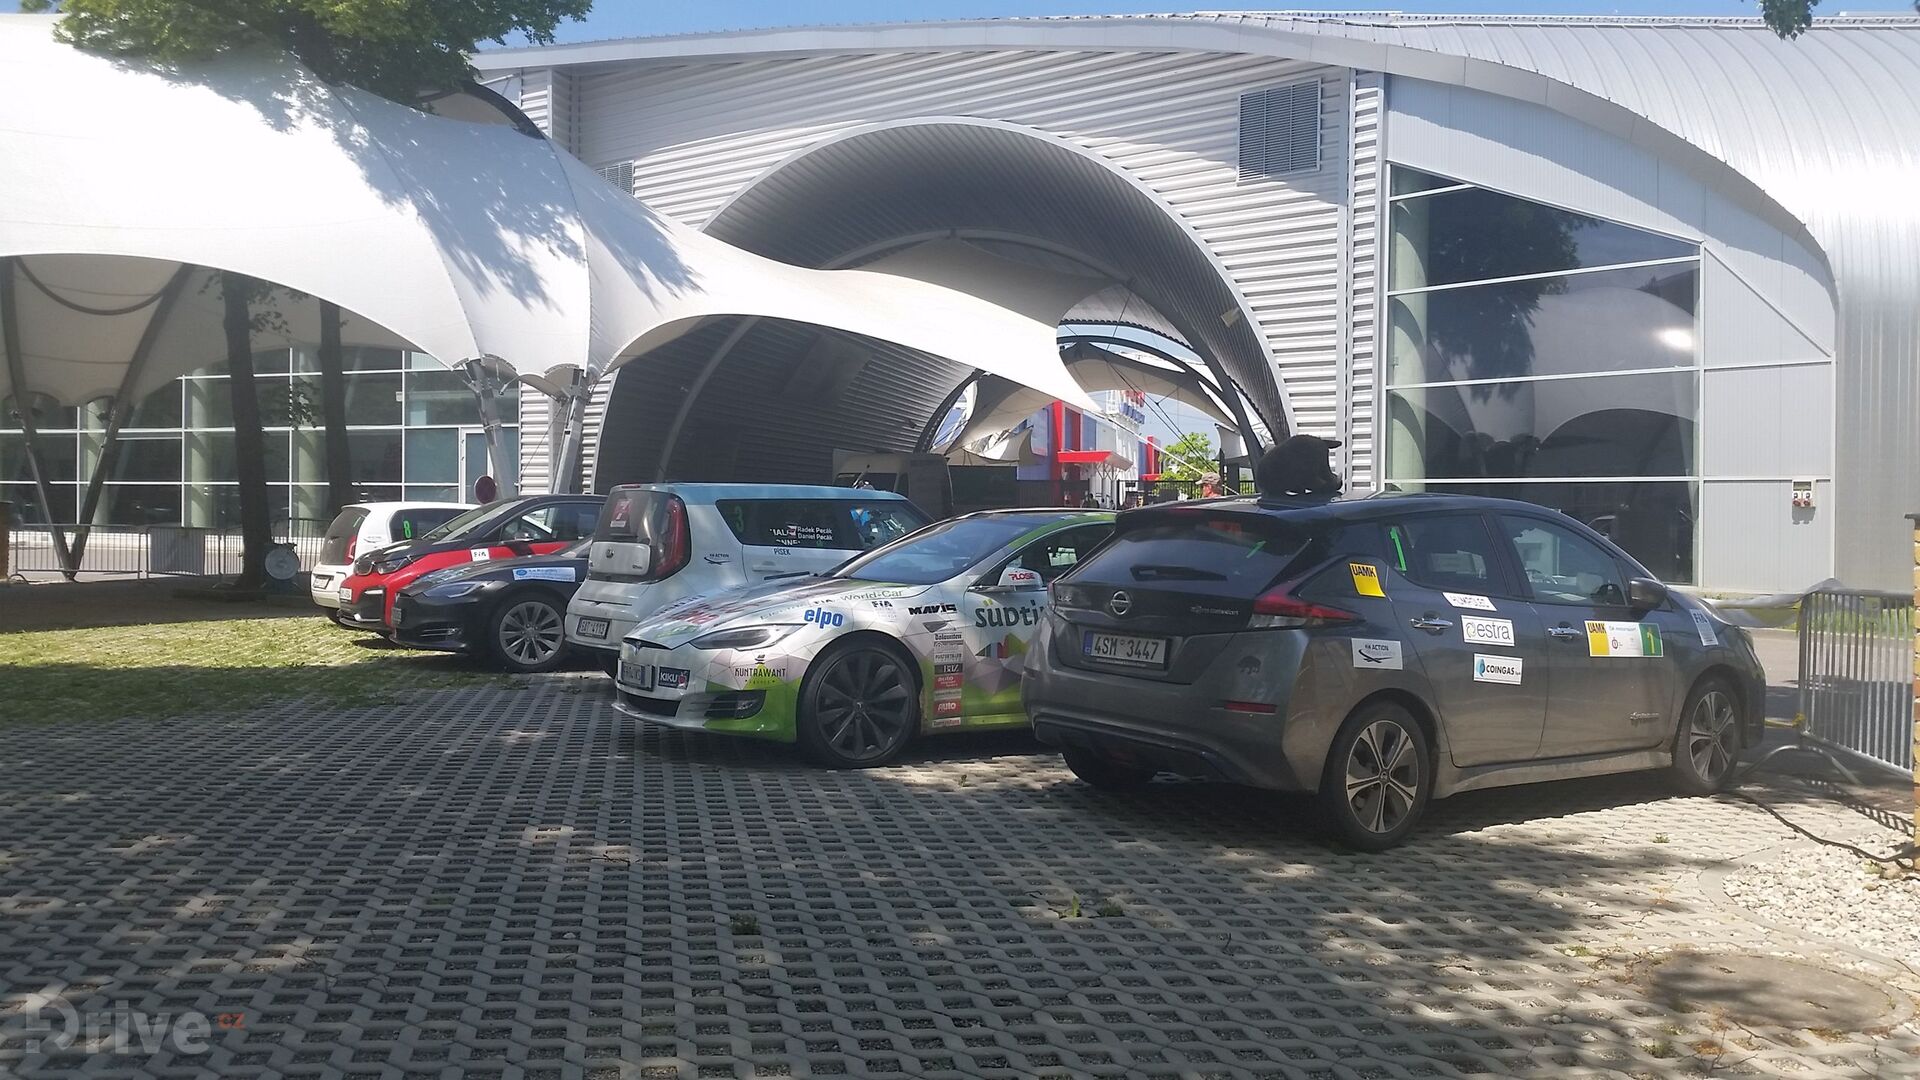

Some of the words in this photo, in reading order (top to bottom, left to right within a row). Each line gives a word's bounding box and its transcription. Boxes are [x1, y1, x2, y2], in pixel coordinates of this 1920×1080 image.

[403, 520, 411, 539] 8
[804, 607, 843, 629] elpo
[1476, 622, 1511, 641] estra
[1094, 636, 1118, 656] 4SM
[1126, 639, 1159, 661] 3447
[660, 671, 678, 683] KIKU
[1486, 664, 1515, 676] COINGAS
